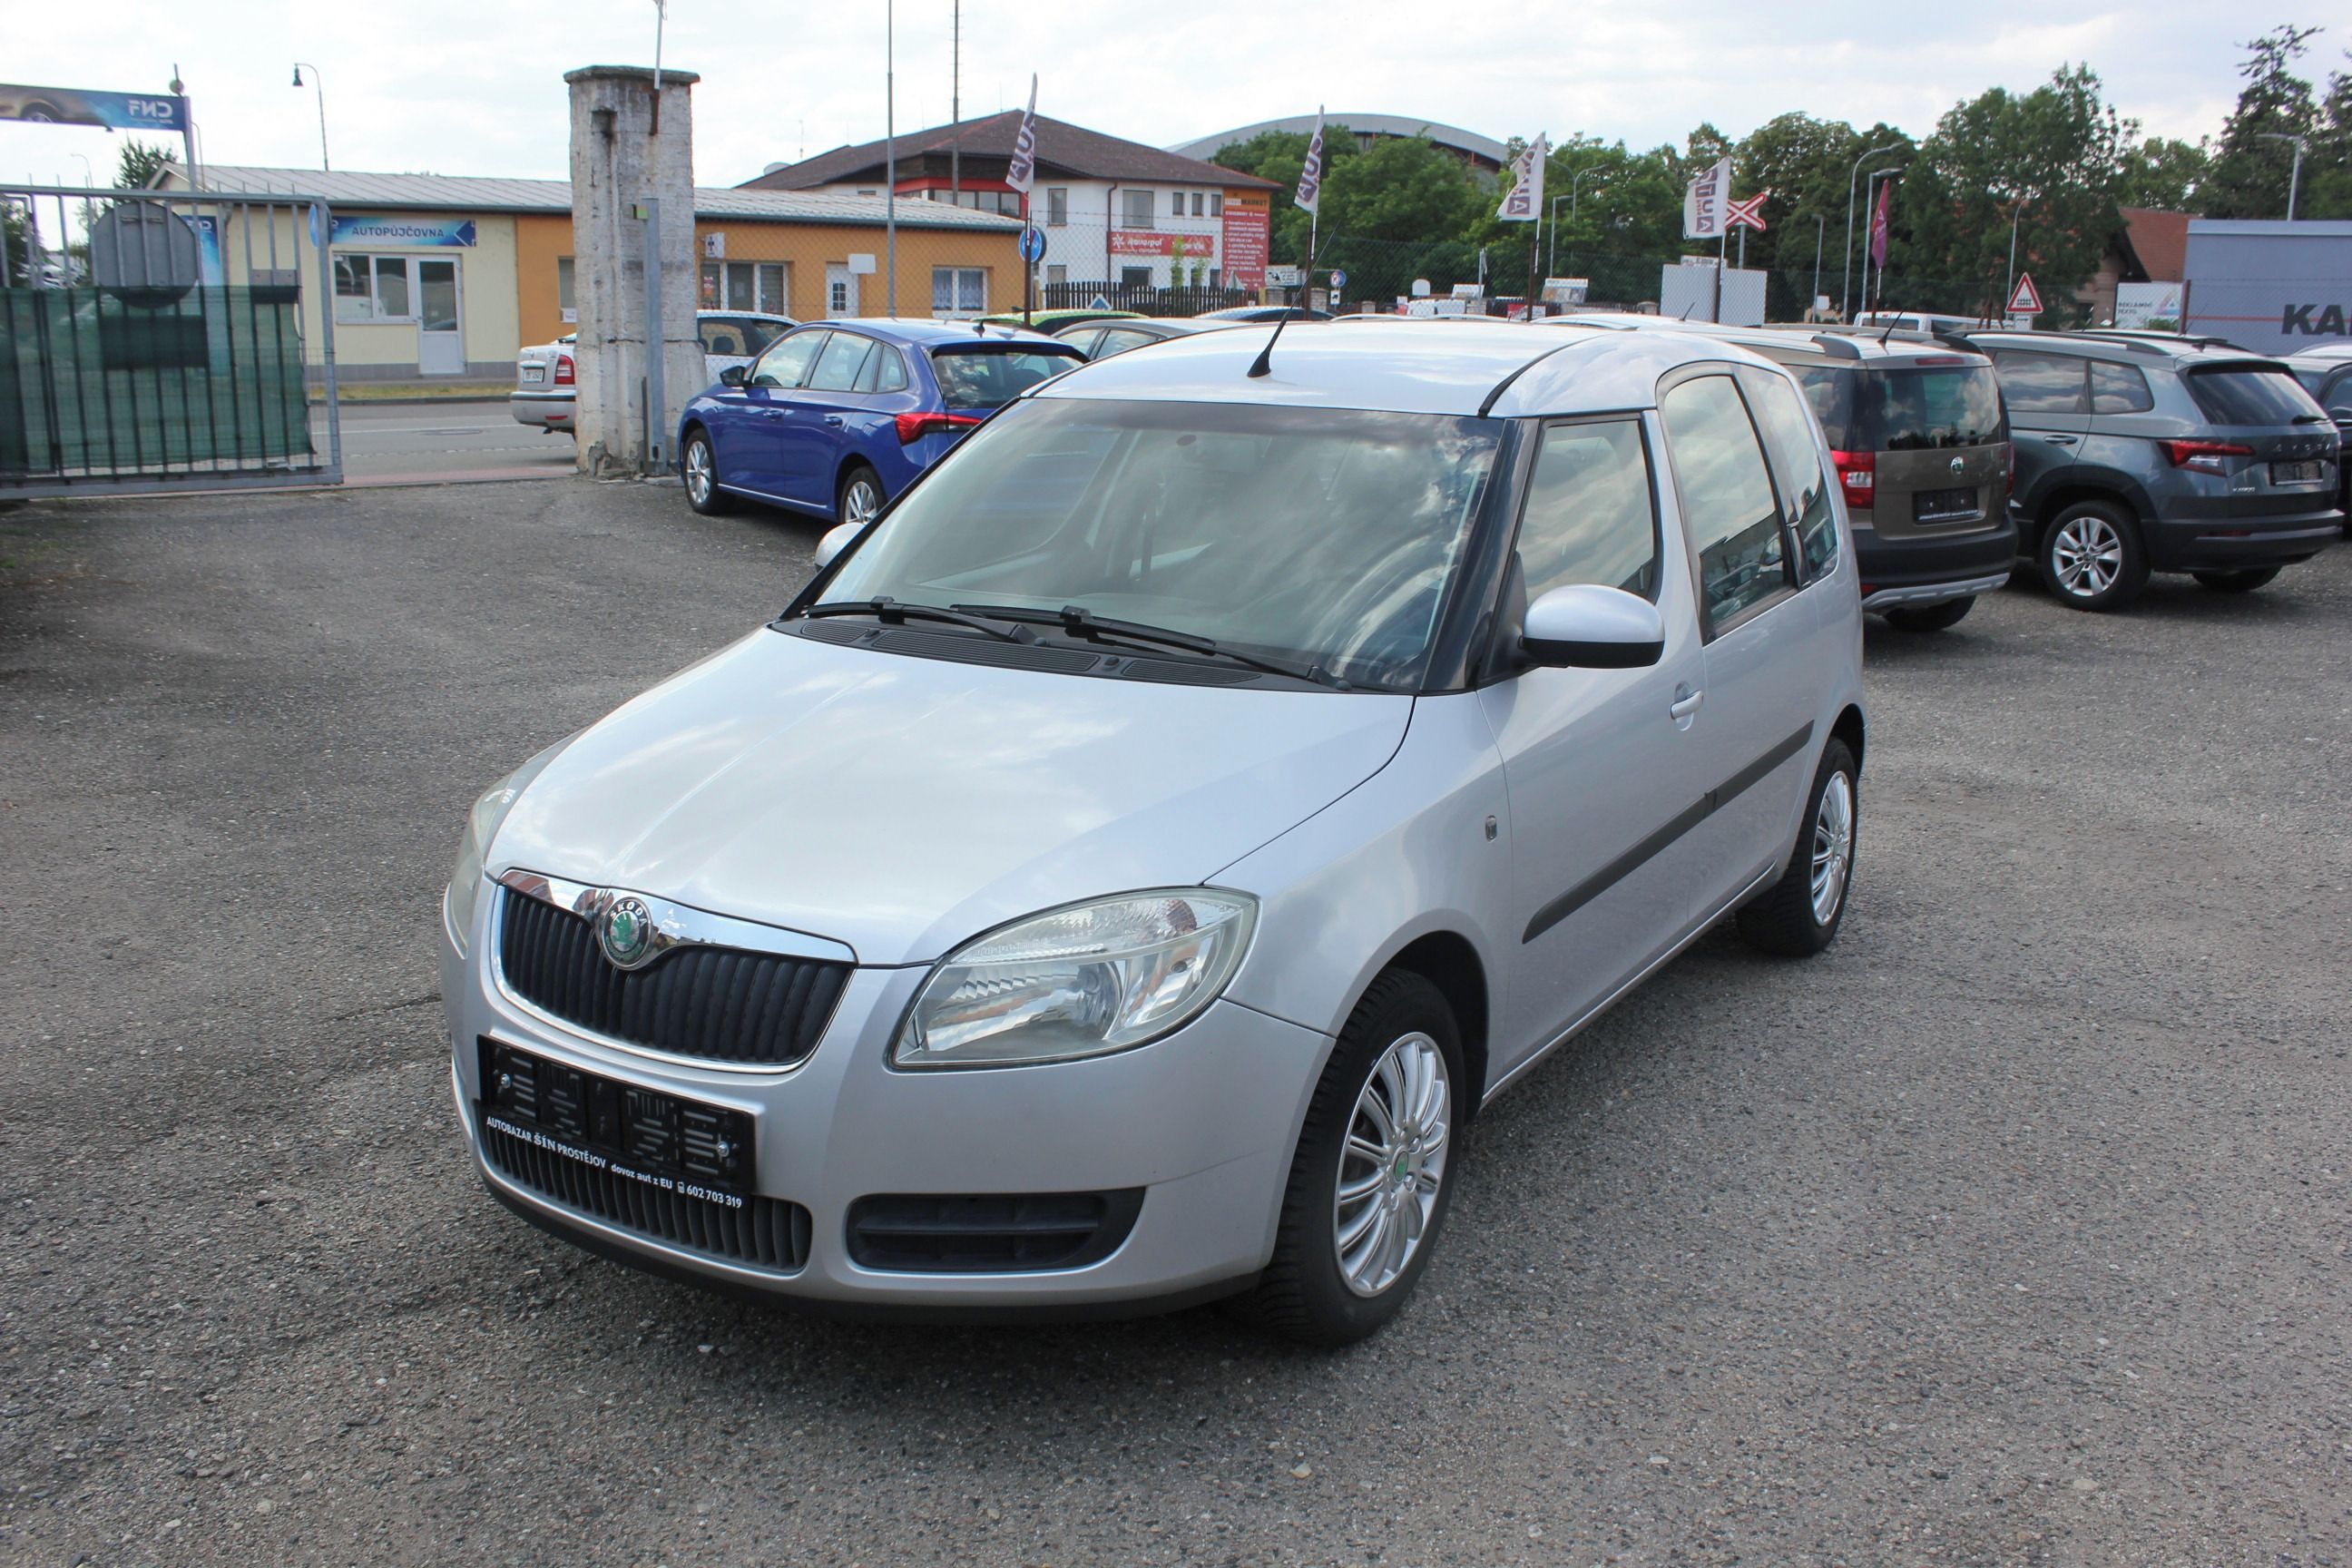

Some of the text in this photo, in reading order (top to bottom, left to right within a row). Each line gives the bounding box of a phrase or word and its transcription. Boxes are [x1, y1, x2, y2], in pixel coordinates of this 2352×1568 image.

[2281, 304, 2352, 336] KA
[486, 1116, 742, 1209] AUTOBAZAR ŠÍN PROSTĚJOV dovoz aut z EU 602 703 319
